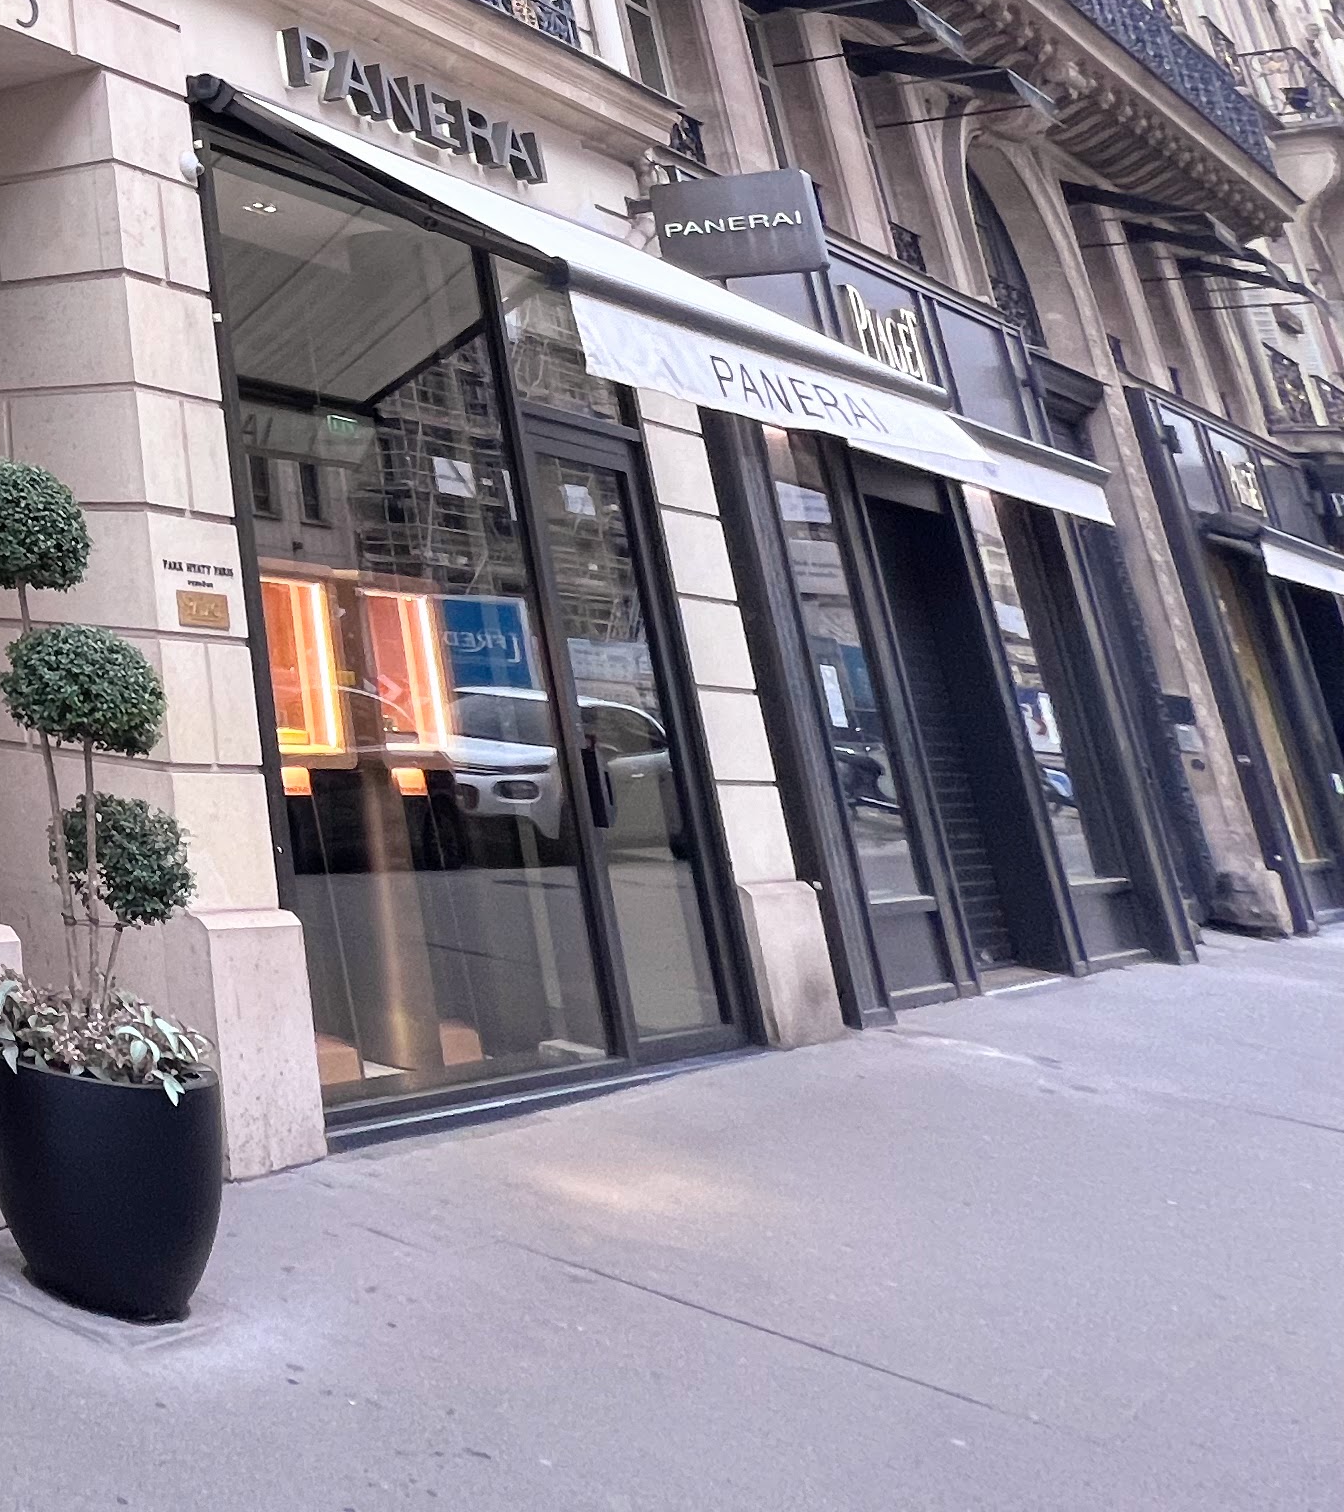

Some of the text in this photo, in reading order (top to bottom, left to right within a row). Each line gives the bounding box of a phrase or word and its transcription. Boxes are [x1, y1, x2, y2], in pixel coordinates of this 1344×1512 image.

[276, 26, 549, 185] PANERAI
[664, 210, 803, 238] PANERAI
[845, 283, 928, 383] PIAGET
[709, 354, 890, 434] PANERAI
